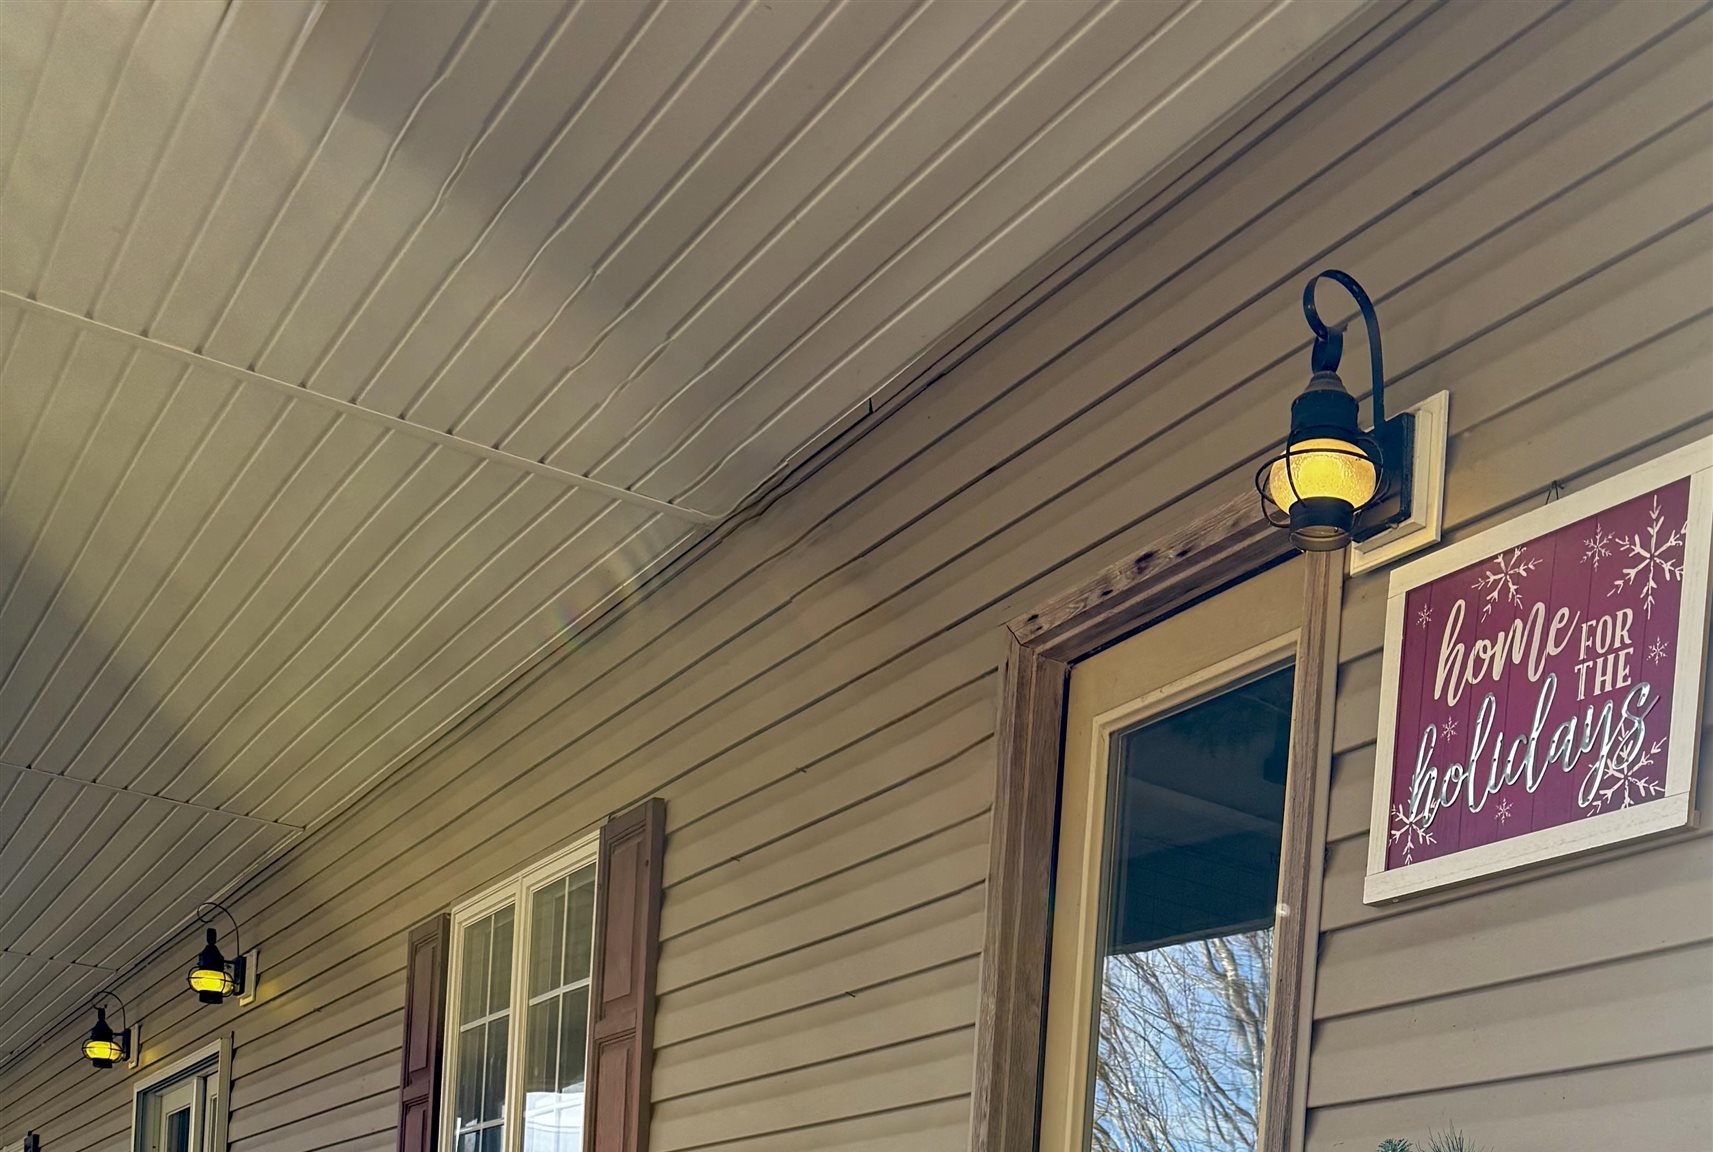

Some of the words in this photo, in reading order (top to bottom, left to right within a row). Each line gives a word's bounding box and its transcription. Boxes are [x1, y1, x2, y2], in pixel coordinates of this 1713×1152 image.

[1434, 599, 1580, 707] home
[1579, 607, 1633, 660] FOR
[1575, 648, 1634, 702] THE
[1411, 673, 1660, 827] holidays
